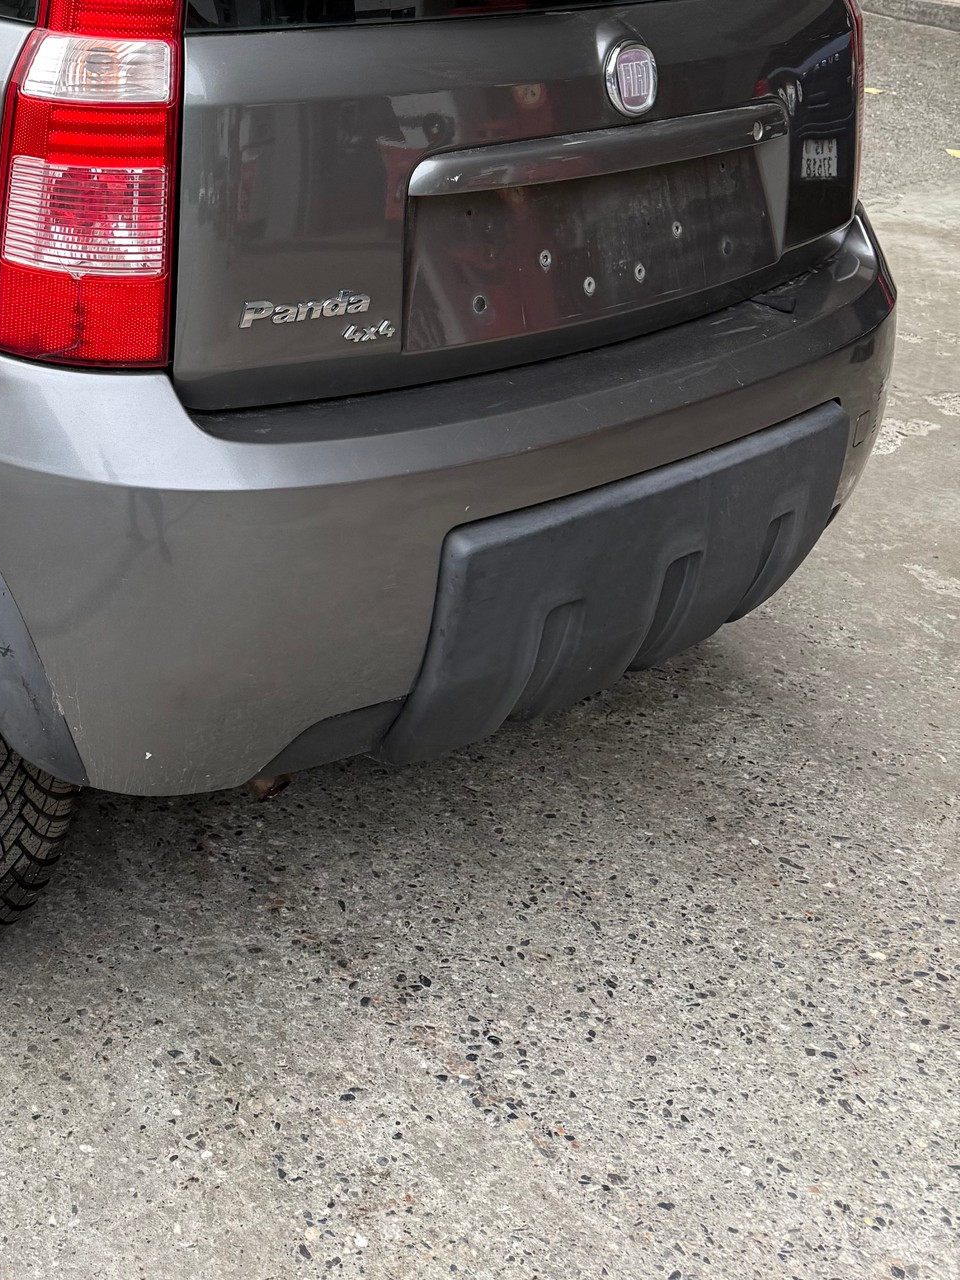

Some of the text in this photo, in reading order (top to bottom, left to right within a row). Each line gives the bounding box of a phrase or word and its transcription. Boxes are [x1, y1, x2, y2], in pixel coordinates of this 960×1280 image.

[620, 60, 649, 98] FIAT
[239, 289, 371, 329] Panda
[342, 319, 396, 343] 4x4
